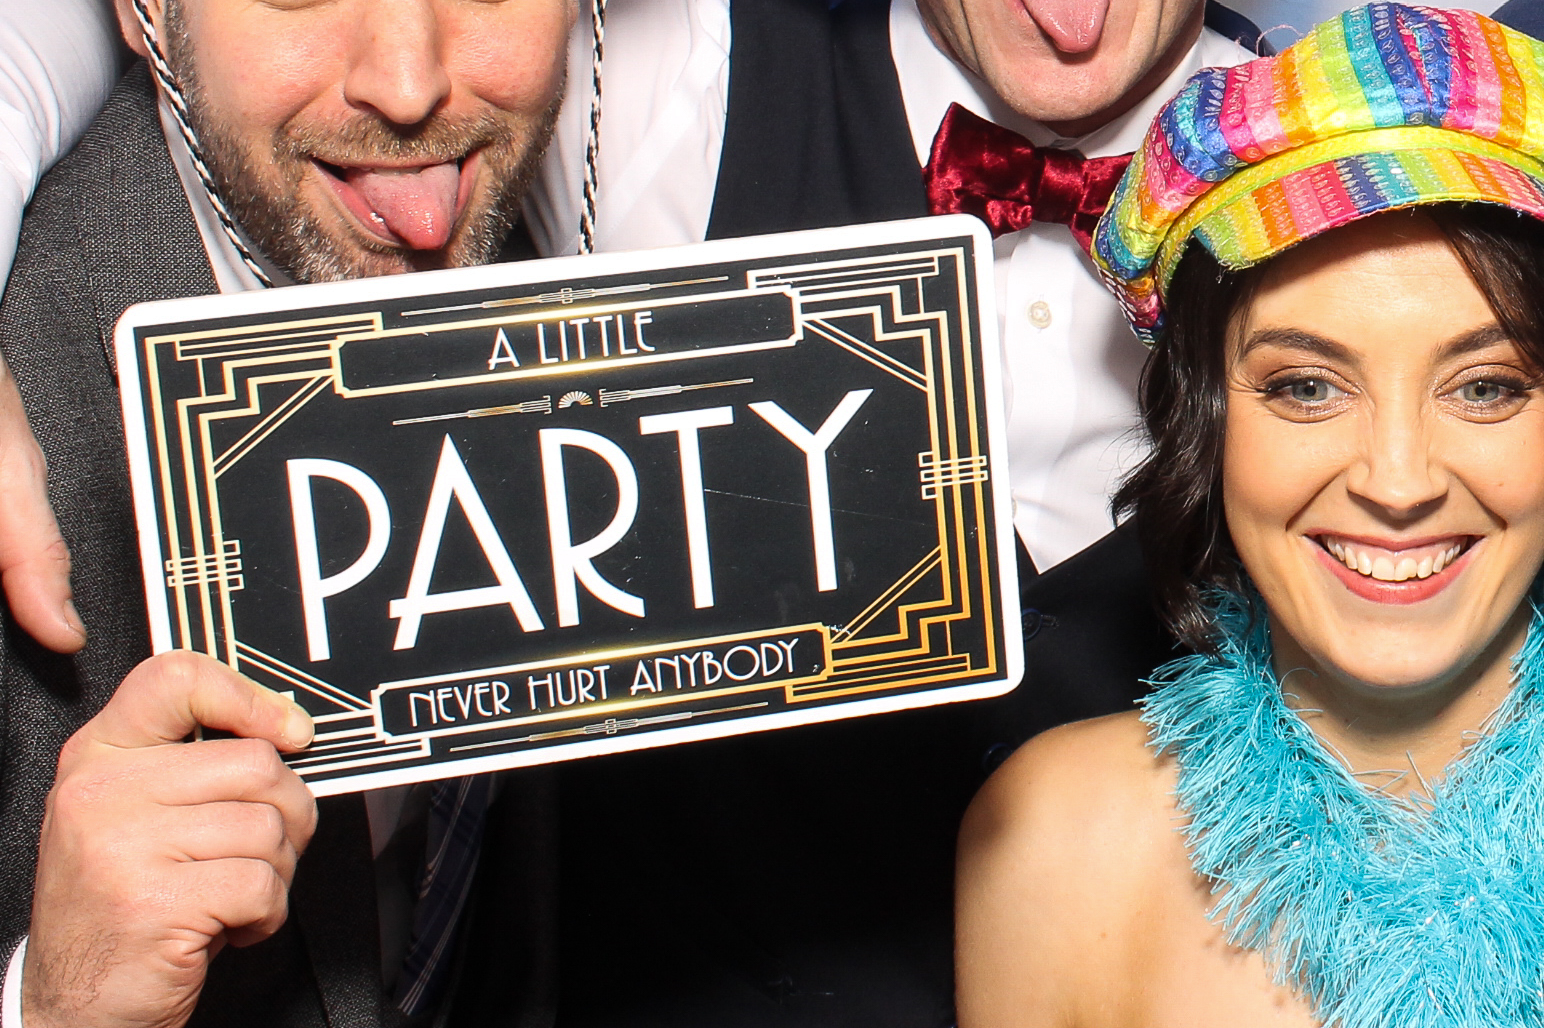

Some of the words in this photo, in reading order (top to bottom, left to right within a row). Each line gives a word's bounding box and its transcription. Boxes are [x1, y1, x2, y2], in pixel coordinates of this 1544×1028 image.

[487, 326, 521, 371] A
[536, 310, 656, 365] LITTLE
[285, 388, 874, 662] PARTY
[408, 680, 511, 727] NEVER
[528, 664, 611, 710] HURT
[629, 637, 799, 697] ANYBODY
